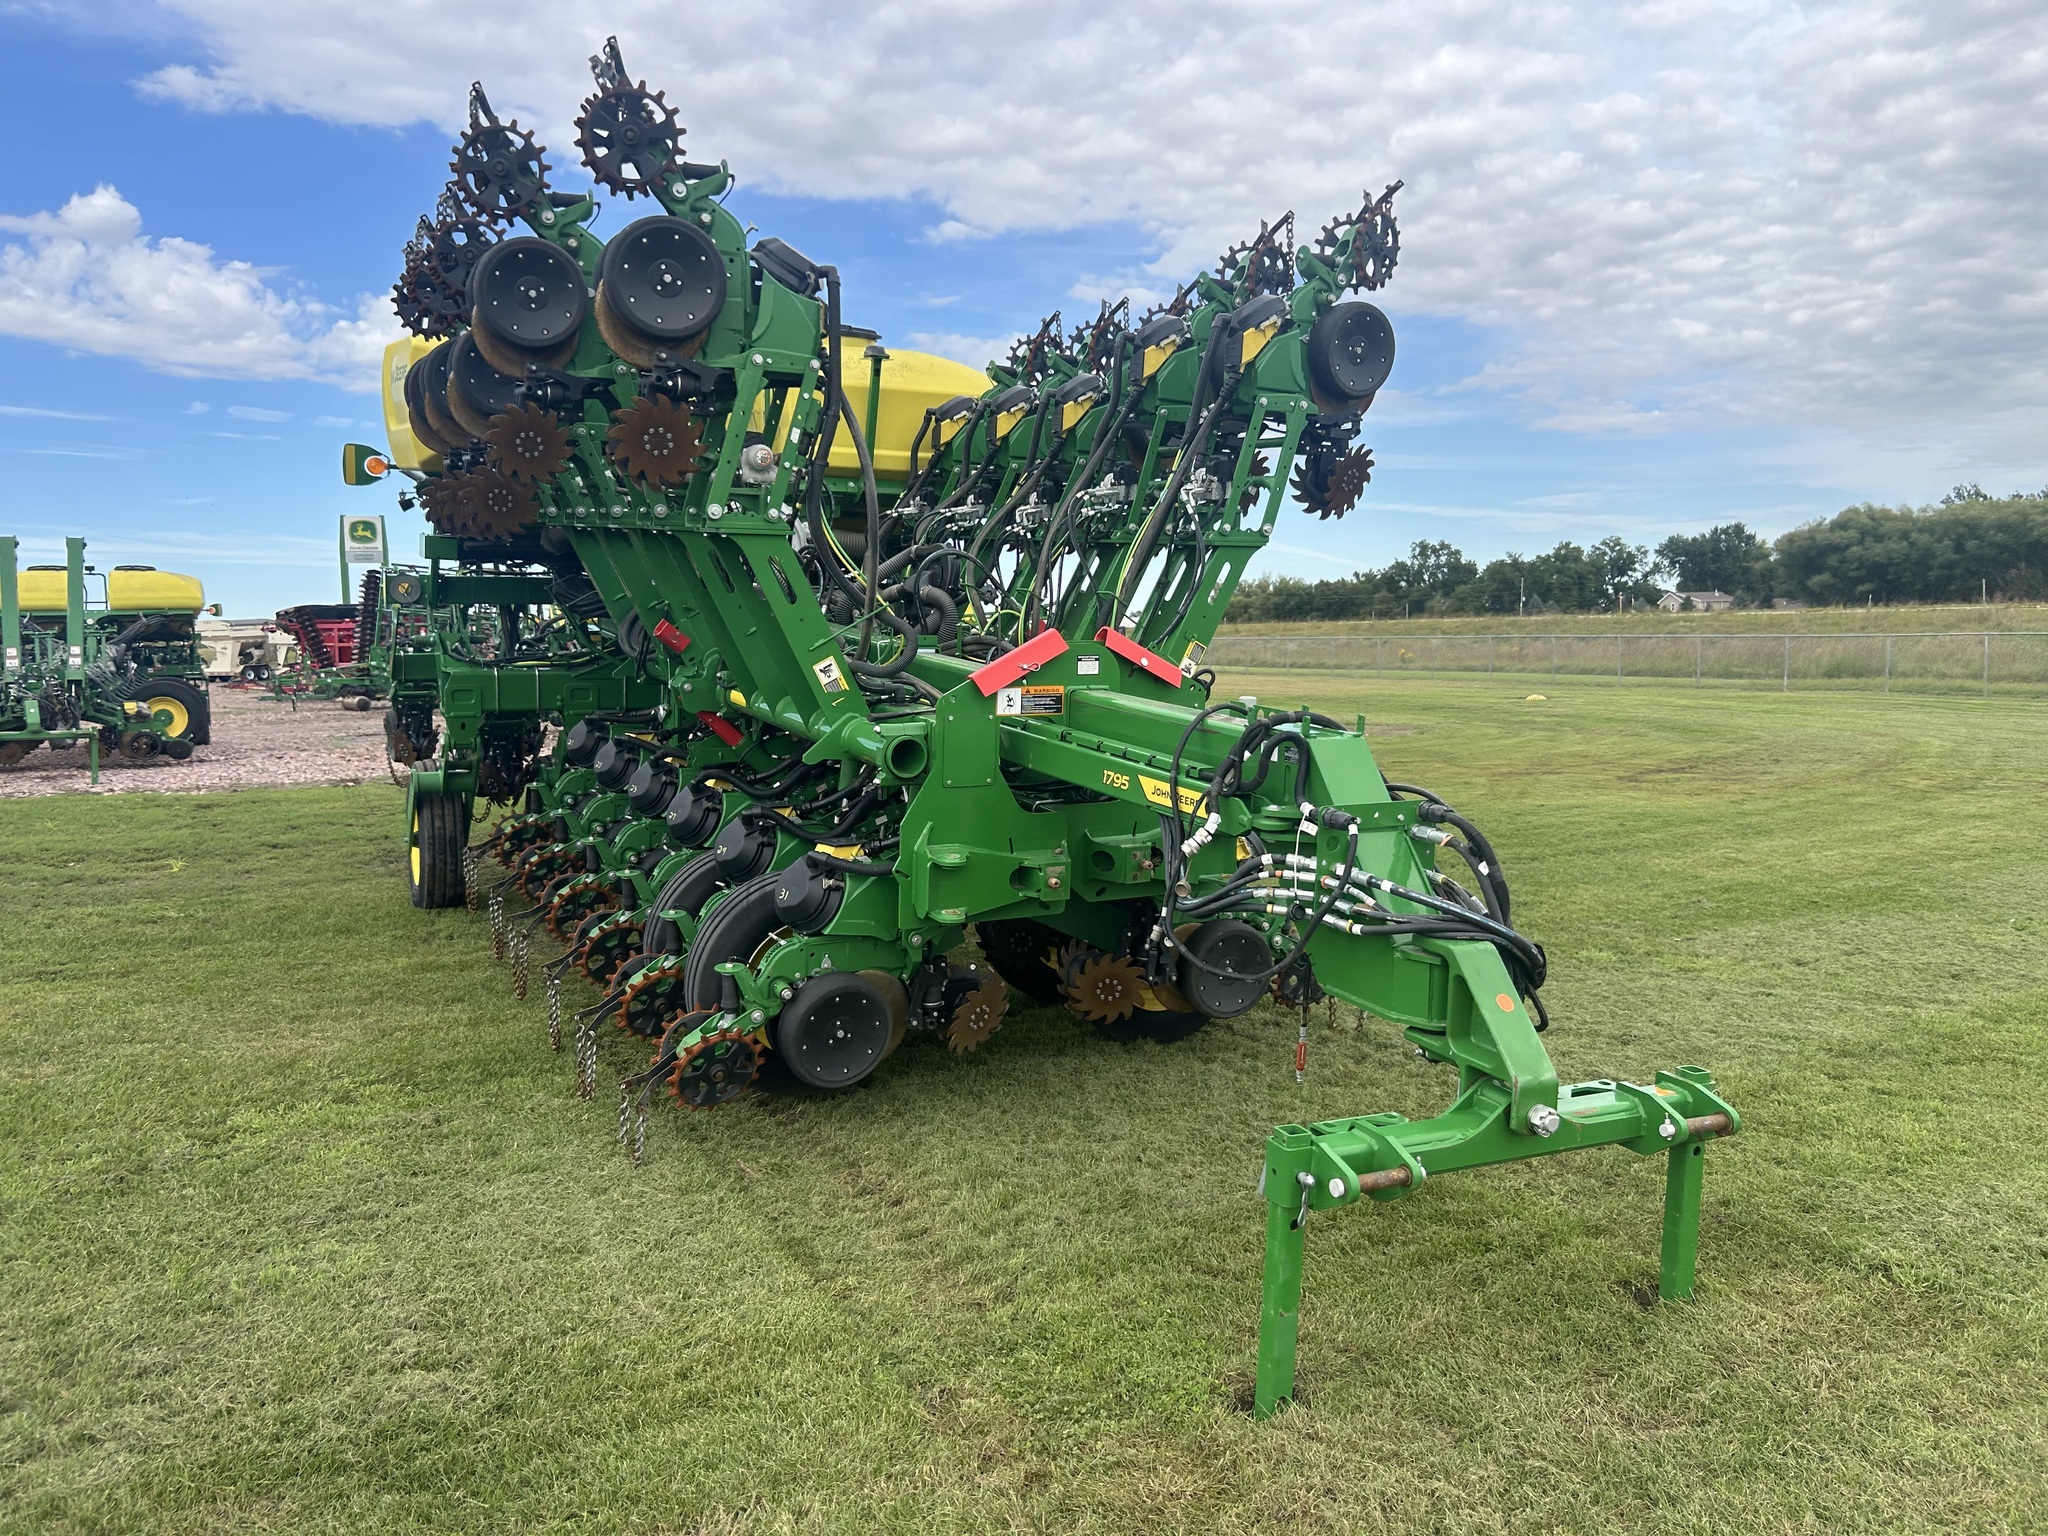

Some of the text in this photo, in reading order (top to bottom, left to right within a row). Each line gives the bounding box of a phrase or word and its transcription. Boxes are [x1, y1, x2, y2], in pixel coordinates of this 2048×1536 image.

[1102, 769, 1130, 790] 1795
[630, 784, 638, 793] 25
[1151, 785, 1172, 799] JOHN
[669, 811, 677, 820] 27
[716, 845, 727, 856] 29
[778, 888, 790, 901] 31
